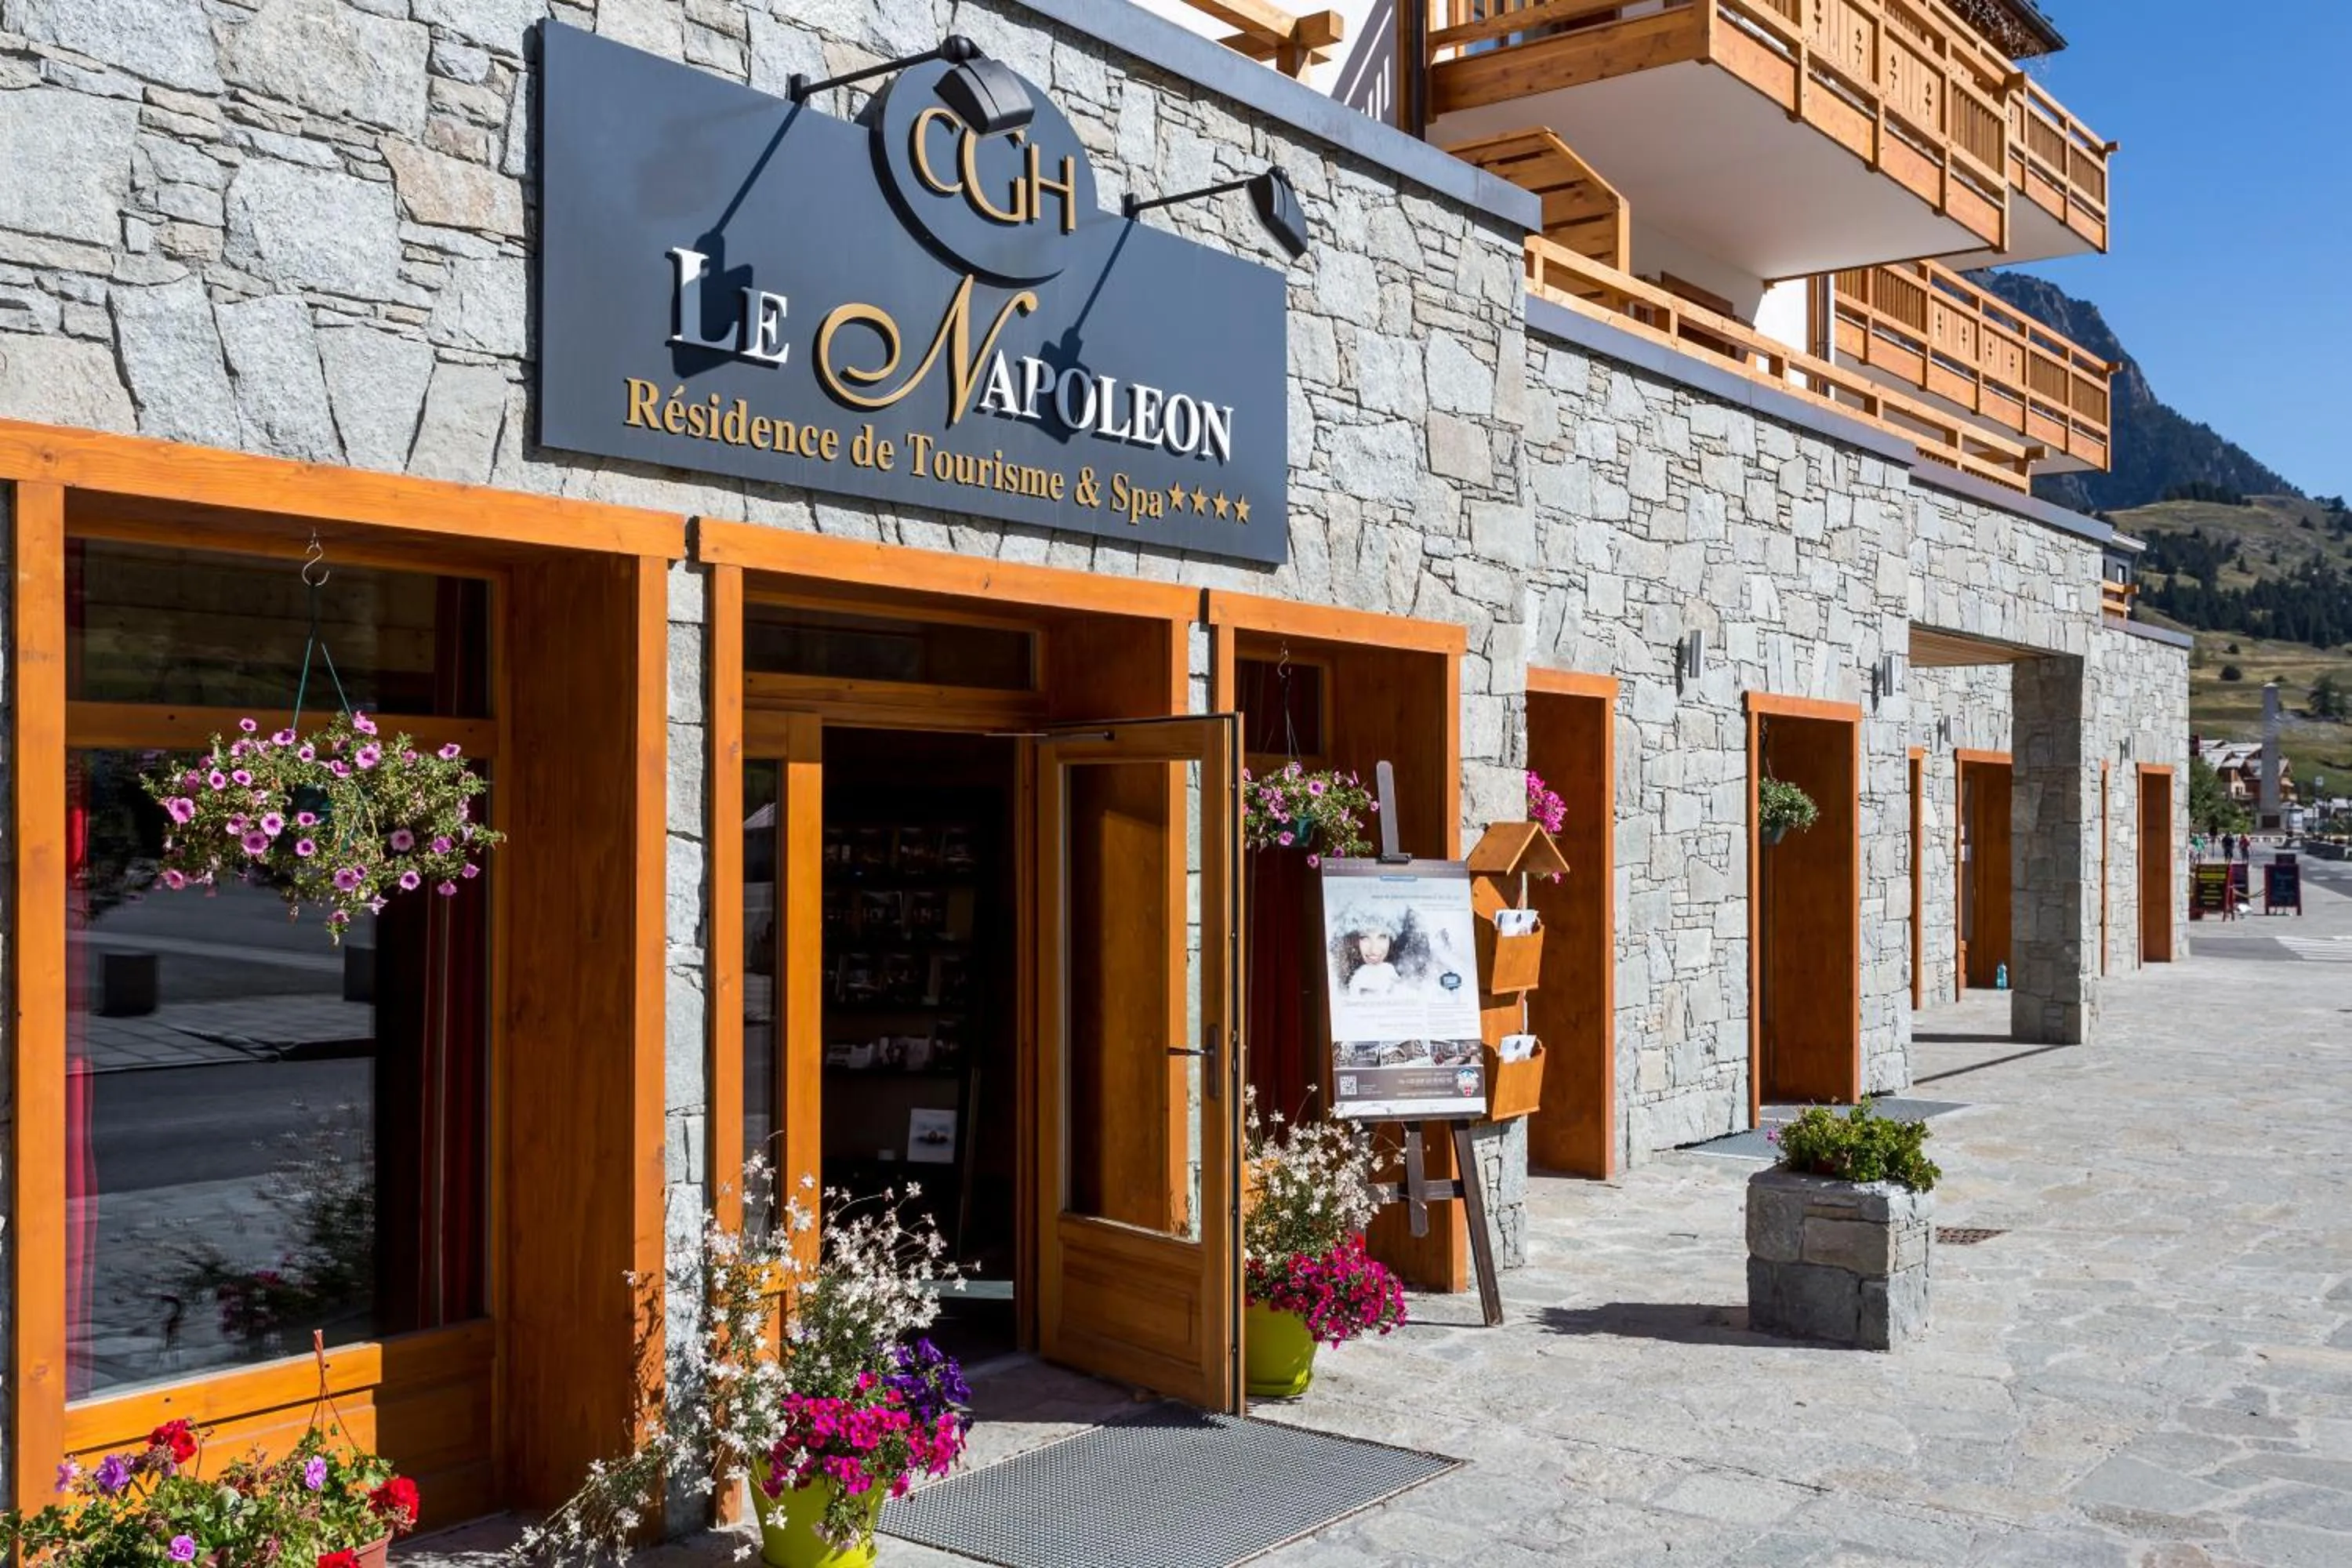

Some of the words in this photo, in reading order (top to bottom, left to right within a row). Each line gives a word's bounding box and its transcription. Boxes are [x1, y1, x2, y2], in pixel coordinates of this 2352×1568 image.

[915, 107, 1076, 230] CGH
[672, 247, 789, 364] LE
[818, 274, 1234, 462] NAPOLEON
[626, 376, 839, 460] Résidence
[852, 424, 895, 470] de
[907, 433, 1065, 500] Tourisme
[1075, 466, 1101, 508] &
[1111, 473, 1163, 524] Spa
